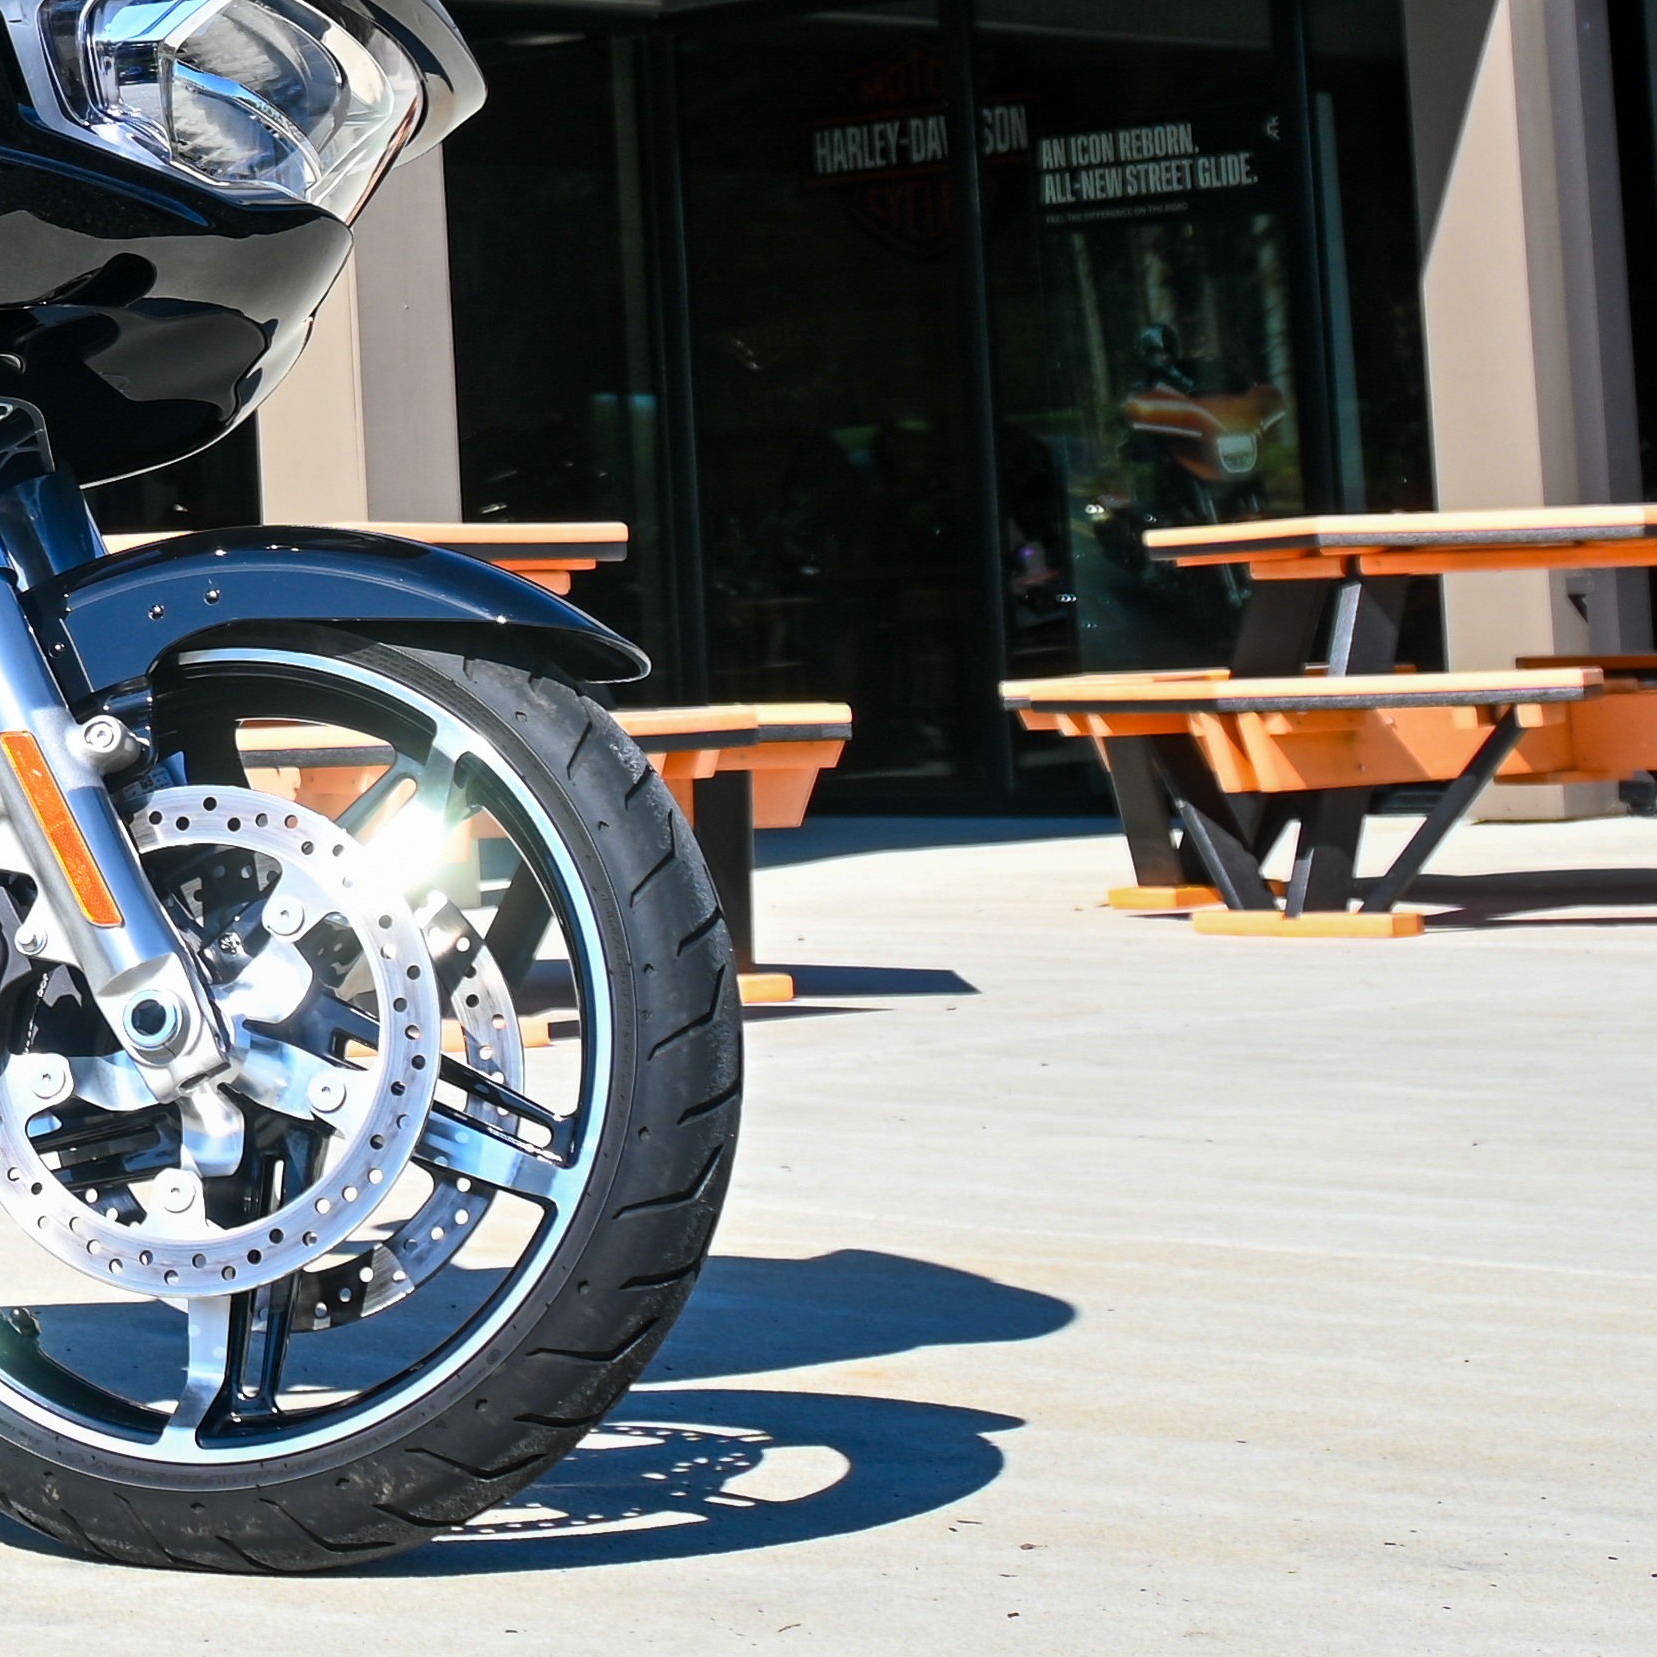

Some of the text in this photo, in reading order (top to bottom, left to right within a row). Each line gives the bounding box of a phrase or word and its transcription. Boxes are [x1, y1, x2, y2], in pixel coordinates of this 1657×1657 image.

[1041, 123, 1200, 170] AN ICON REBORN.
[1044, 151, 1259, 204] ALL-NEW STREET GLIDE.
